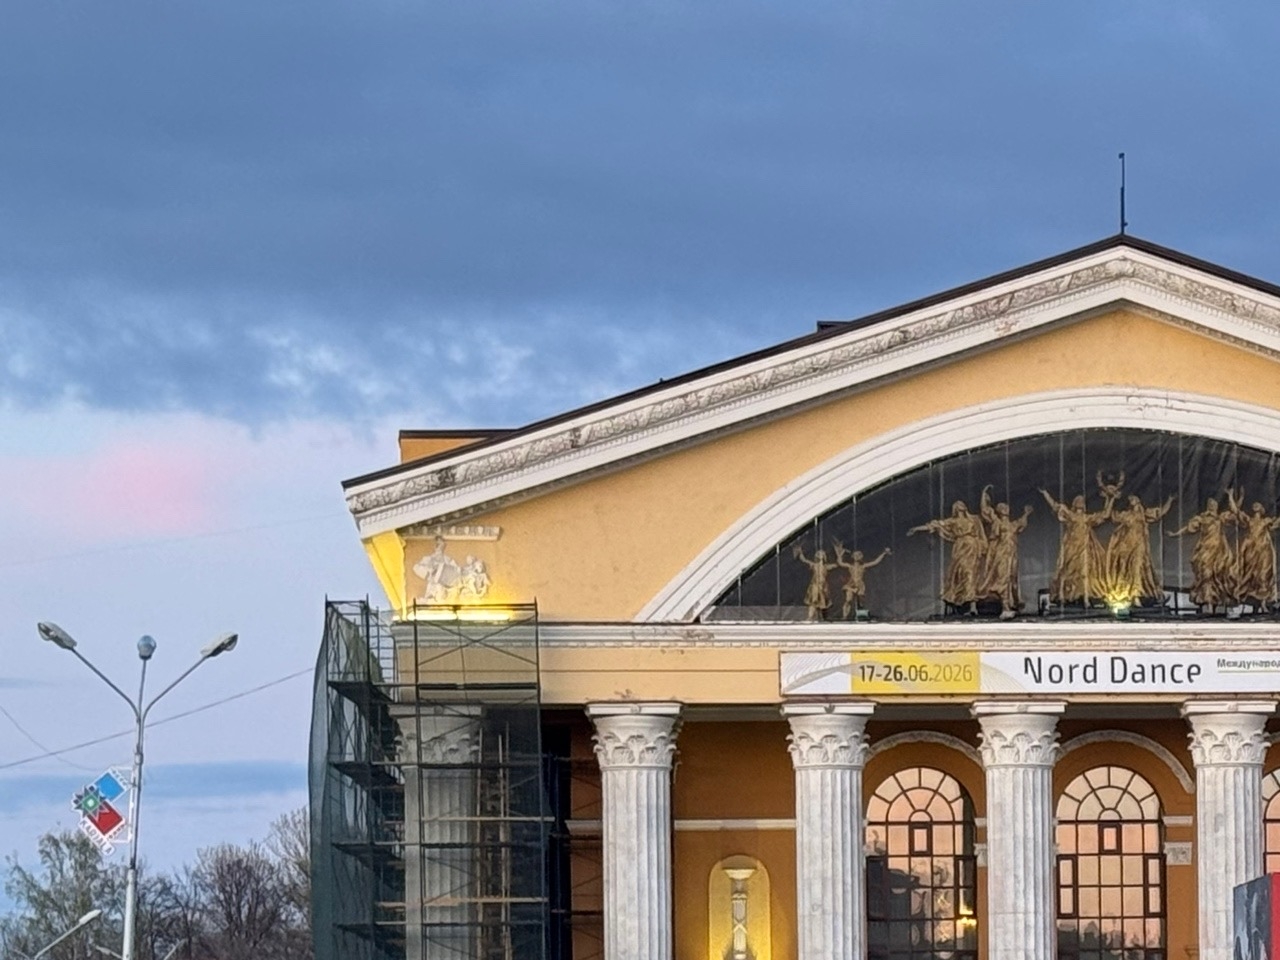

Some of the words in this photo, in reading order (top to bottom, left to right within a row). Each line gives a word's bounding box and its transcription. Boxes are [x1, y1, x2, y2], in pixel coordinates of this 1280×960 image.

[859, 664, 973, 683] 17-26.06.2026
[1023, 655, 1098, 684] Nord
[1109, 656, 1201, 684] Dance
